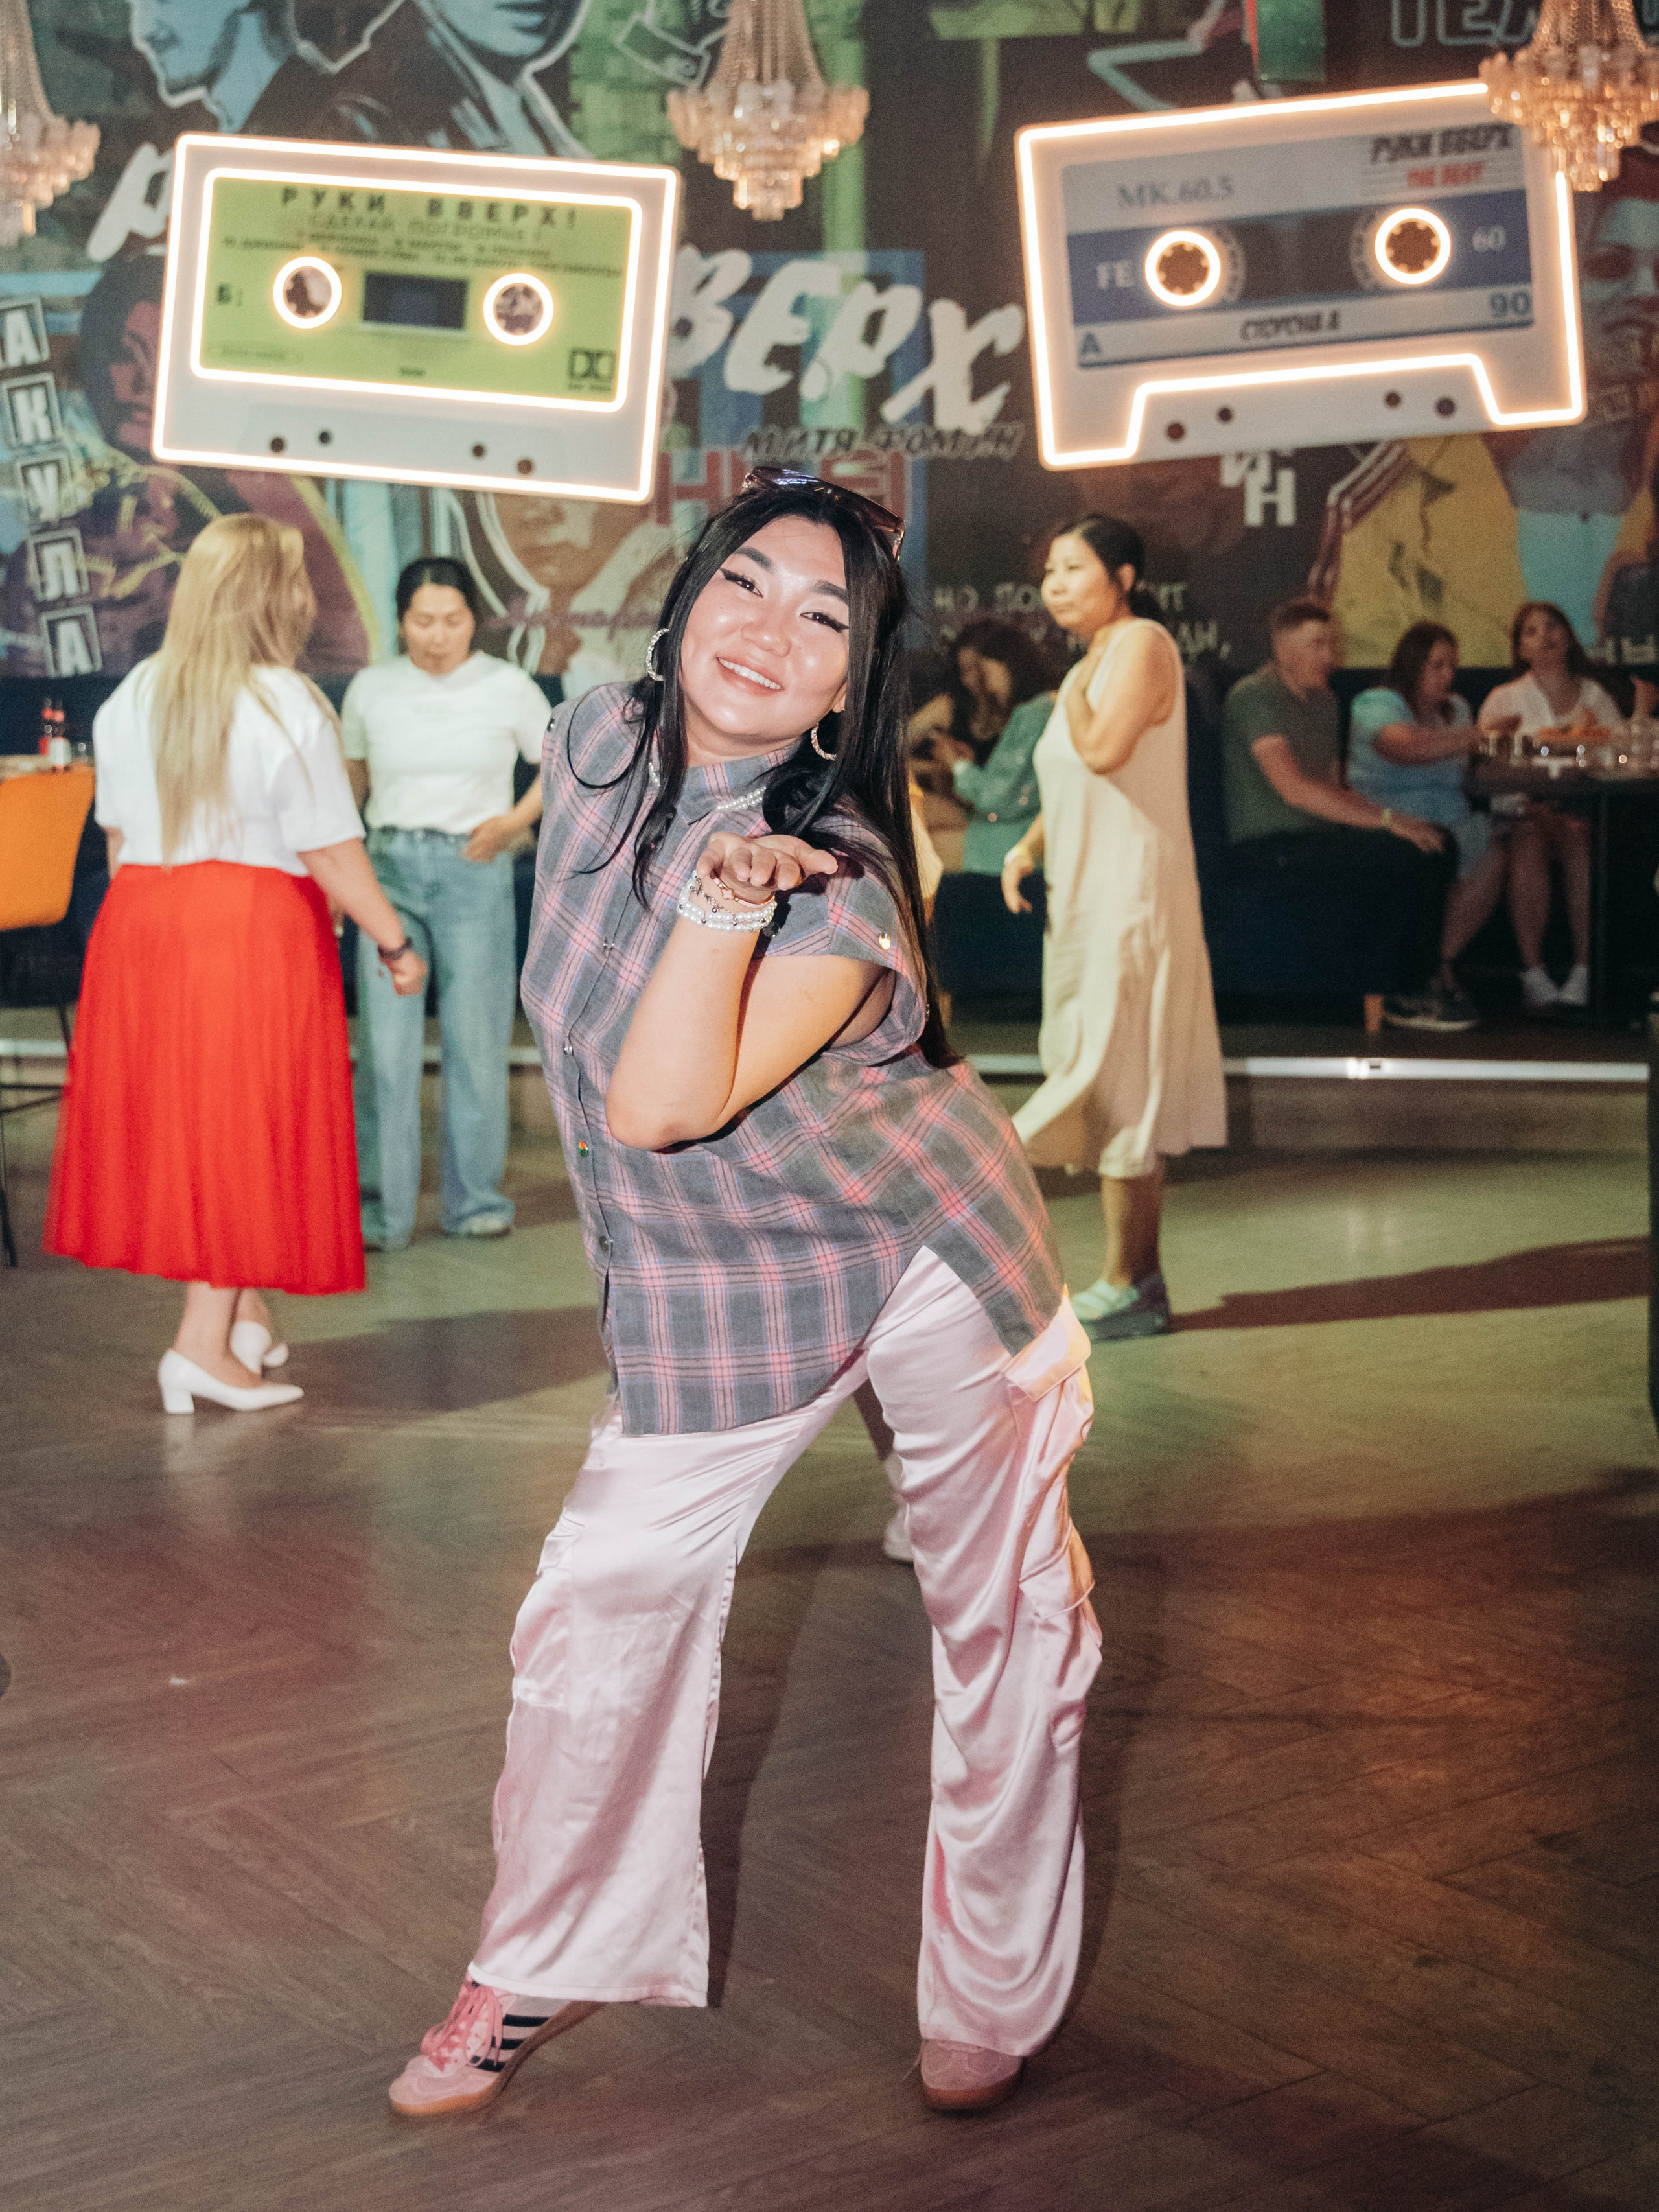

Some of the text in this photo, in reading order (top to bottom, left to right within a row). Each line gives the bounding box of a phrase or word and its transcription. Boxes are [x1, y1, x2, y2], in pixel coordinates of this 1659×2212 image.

[280, 185, 577, 229] РУКИ ВВЕРХ!
[1471, 226, 1507, 253] 60
[1489, 291, 1532, 318] 90
